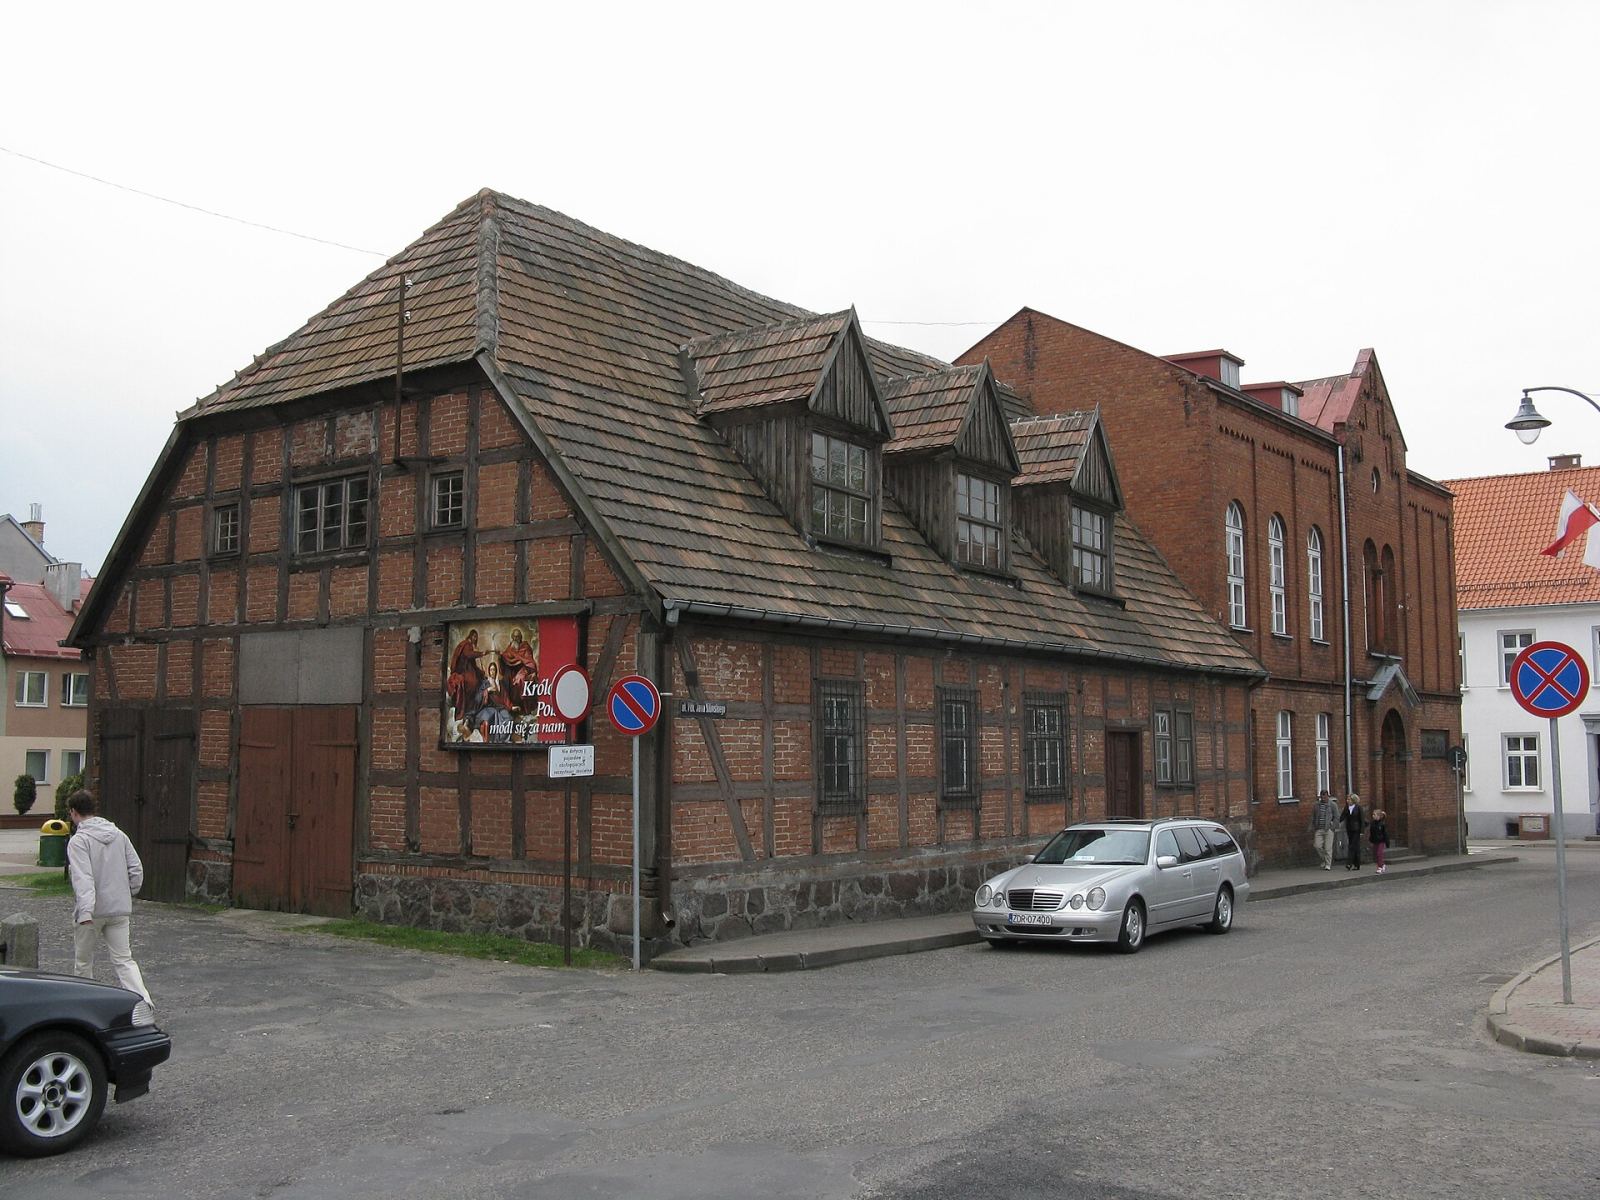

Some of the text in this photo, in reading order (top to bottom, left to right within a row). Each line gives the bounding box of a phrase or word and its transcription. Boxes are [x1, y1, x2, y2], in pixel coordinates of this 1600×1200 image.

[489, 720, 514, 734] módl
[514, 720, 528, 737] się
[528, 723, 540, 734] za
